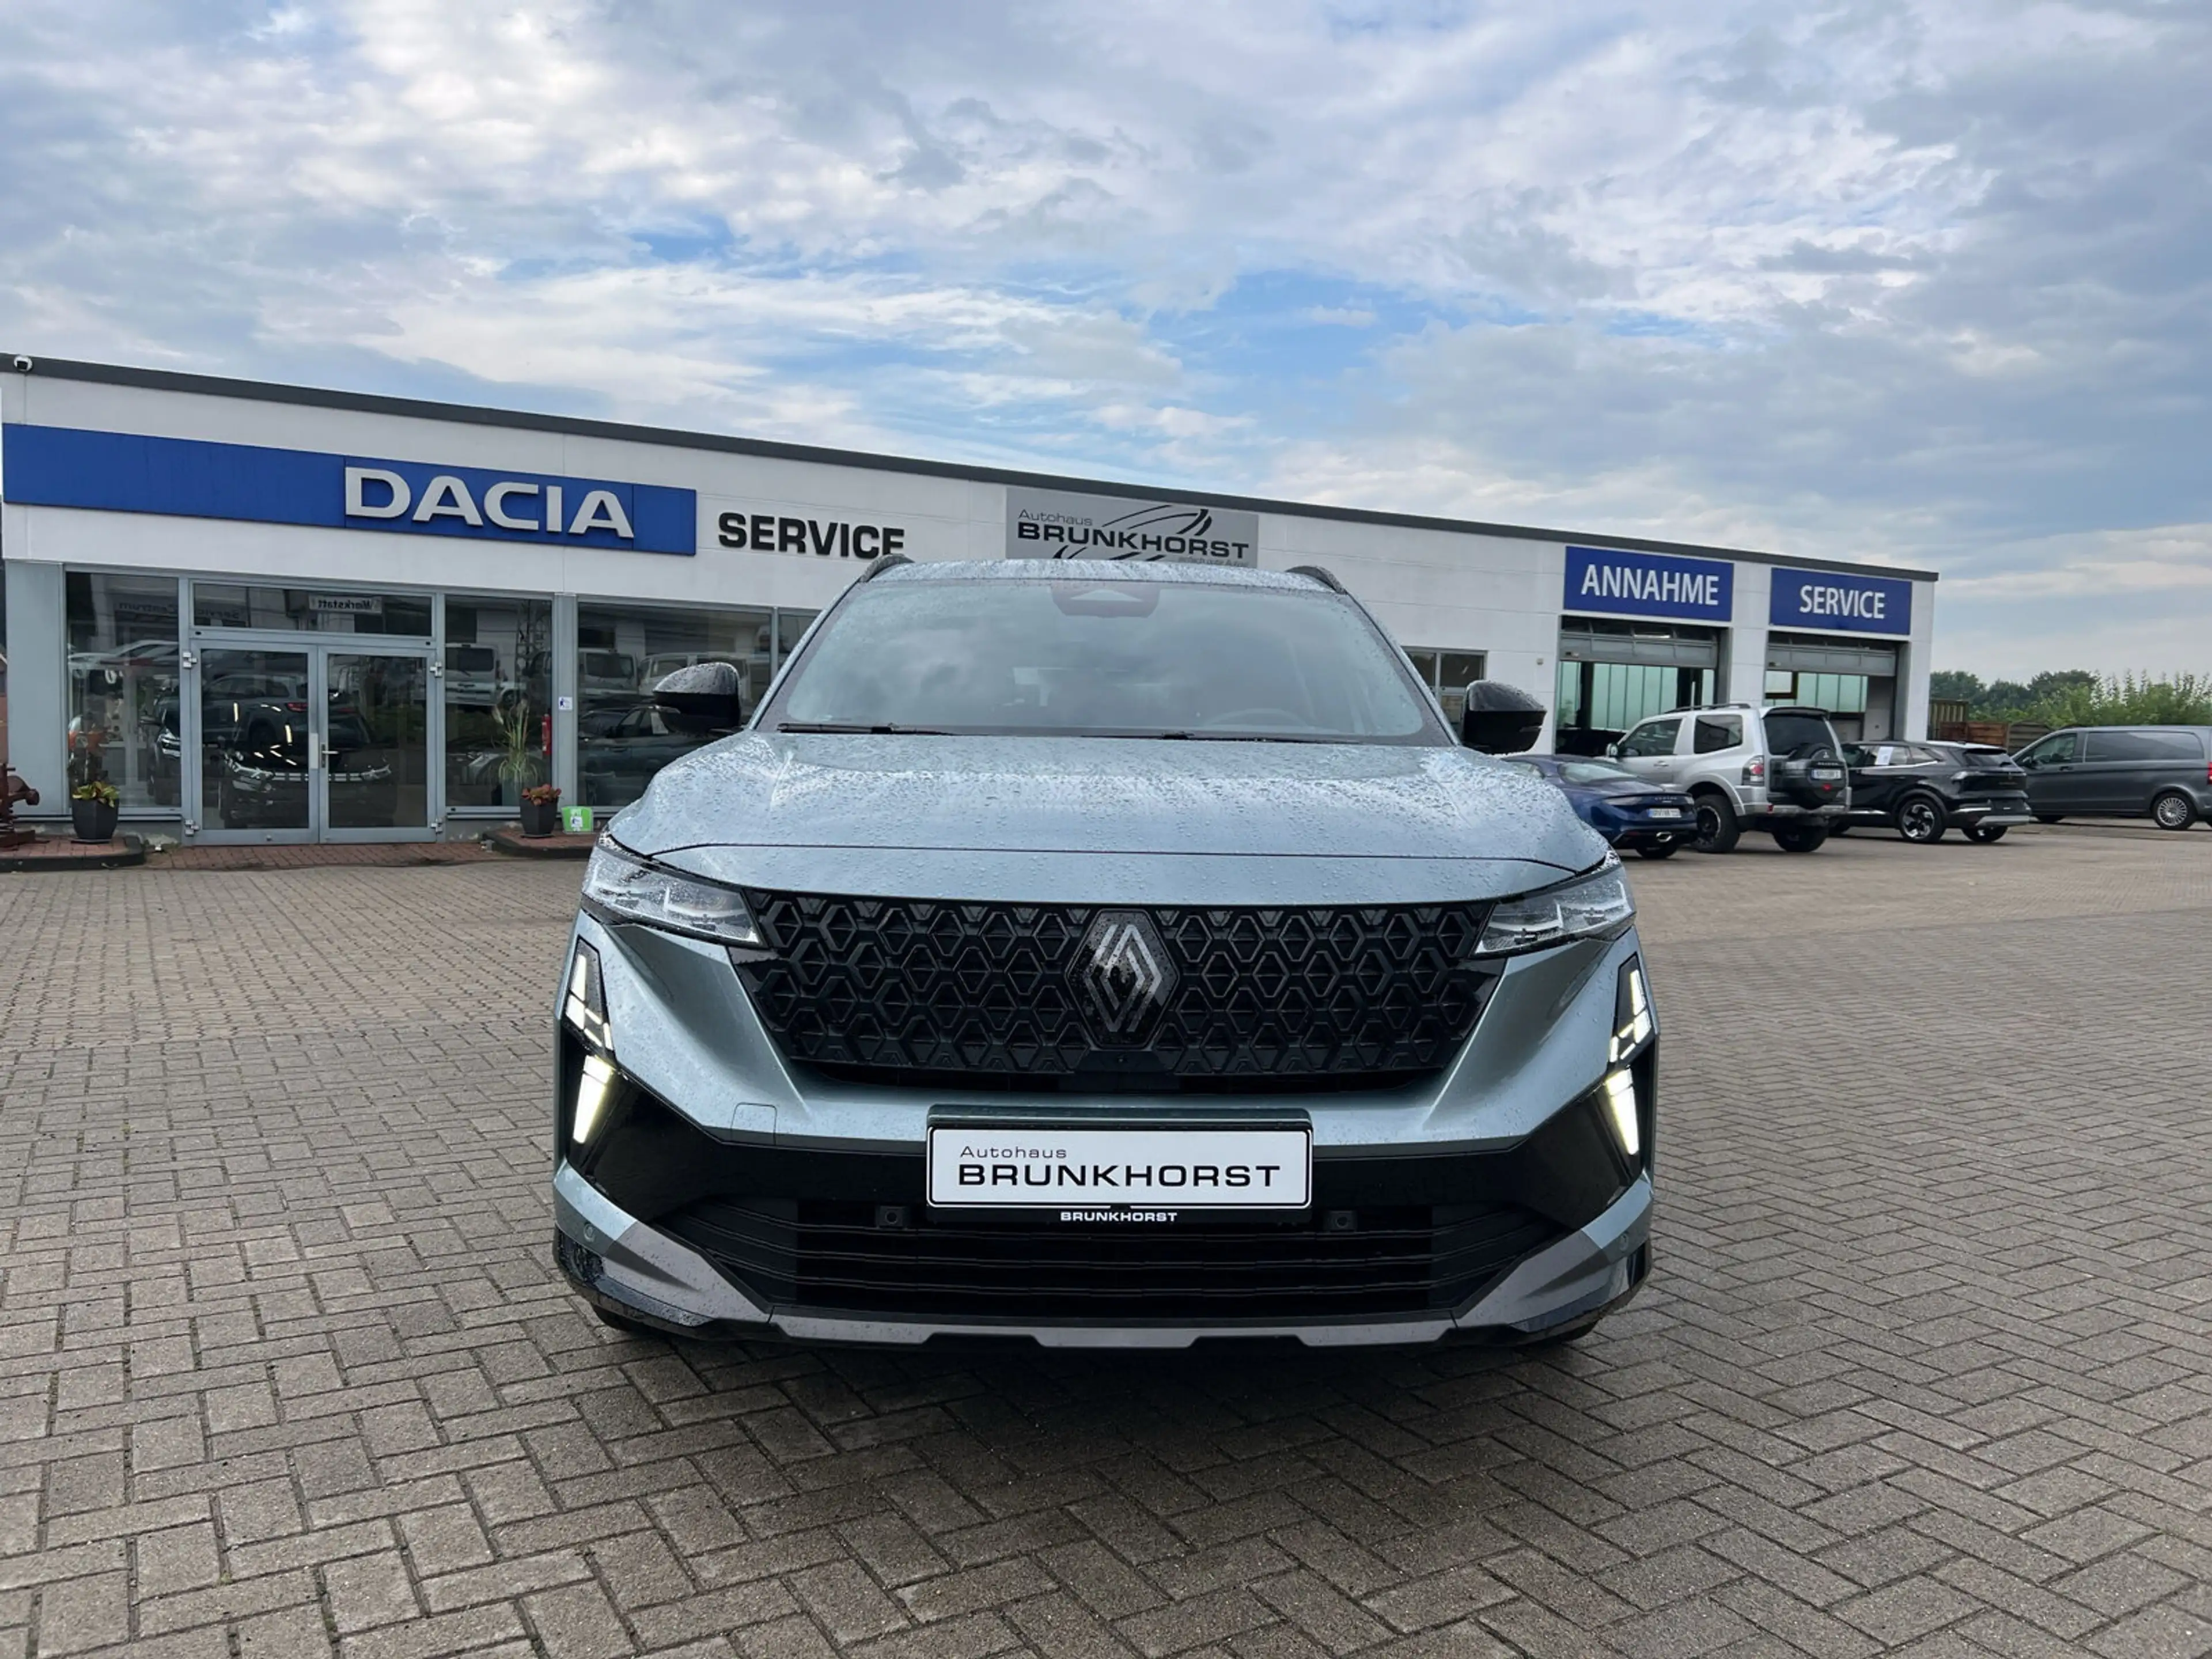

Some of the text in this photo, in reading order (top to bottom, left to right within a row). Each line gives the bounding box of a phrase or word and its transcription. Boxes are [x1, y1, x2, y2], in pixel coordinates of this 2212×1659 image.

[345, 467, 634, 538] DACIA
[1018, 509, 1092, 525] Autohaus
[718, 512, 905, 559] SERVICE
[1018, 522, 1249, 559] BRUNKHORST
[1581, 564, 1719, 605] ANNAHME
[1799, 585, 1885, 619] SERVICE
[960, 1146, 1067, 1158] Autohaus
[959, 1164, 1281, 1187] BRUNKHORST
[1060, 1212, 1177, 1222] BRUNKHORST
